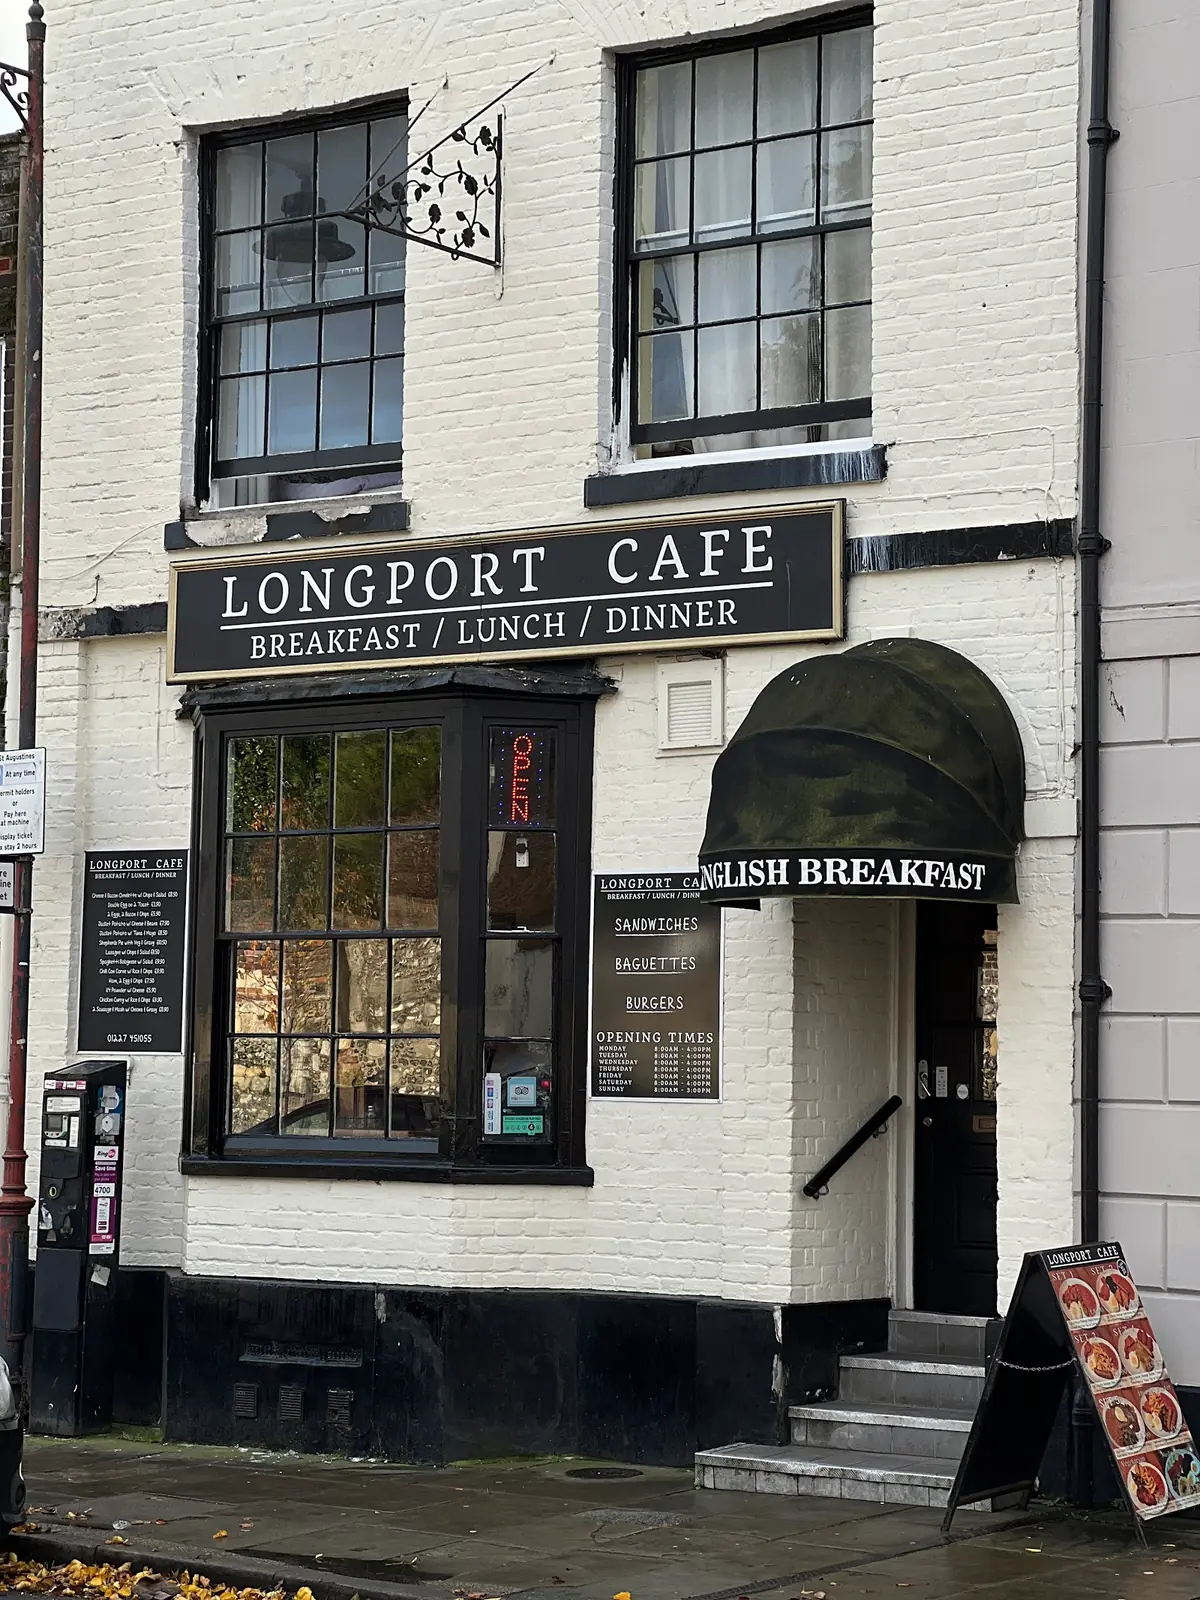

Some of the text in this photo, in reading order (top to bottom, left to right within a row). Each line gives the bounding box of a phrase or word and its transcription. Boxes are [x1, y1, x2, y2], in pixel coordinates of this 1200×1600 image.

[222, 526, 774, 618] LONGPORT CAFE
[250, 599, 738, 659] BREAKFAST / LUNCH / DINNER
[6, 753, 35, 762] Augustines
[512, 735, 532, 821] OPEN
[90, 859, 183, 869] LONGPORT CAFE
[700, 858, 986, 890] NGLISH BREAKFAST
[601, 877, 700, 889] LONGPORT CA
[615, 917, 698, 932] SANDWICHES
[615, 957, 696, 971] BAGUETTES
[626, 996, 684, 1009] BURGERS
[107, 1034, 152, 1042] 01227 451055
[596, 1032, 713, 1043] OPENING TIMES
[97, 1149, 115, 1158] Ring
[1047, 1245, 1118, 1265] LONGPORT CAFE
[1052, 1272, 1066, 1280] SET
[1090, 1265, 1105, 1276] SET
[1113, 1326, 1127, 1337] SET
[1074, 1333, 1089, 1343] SET
